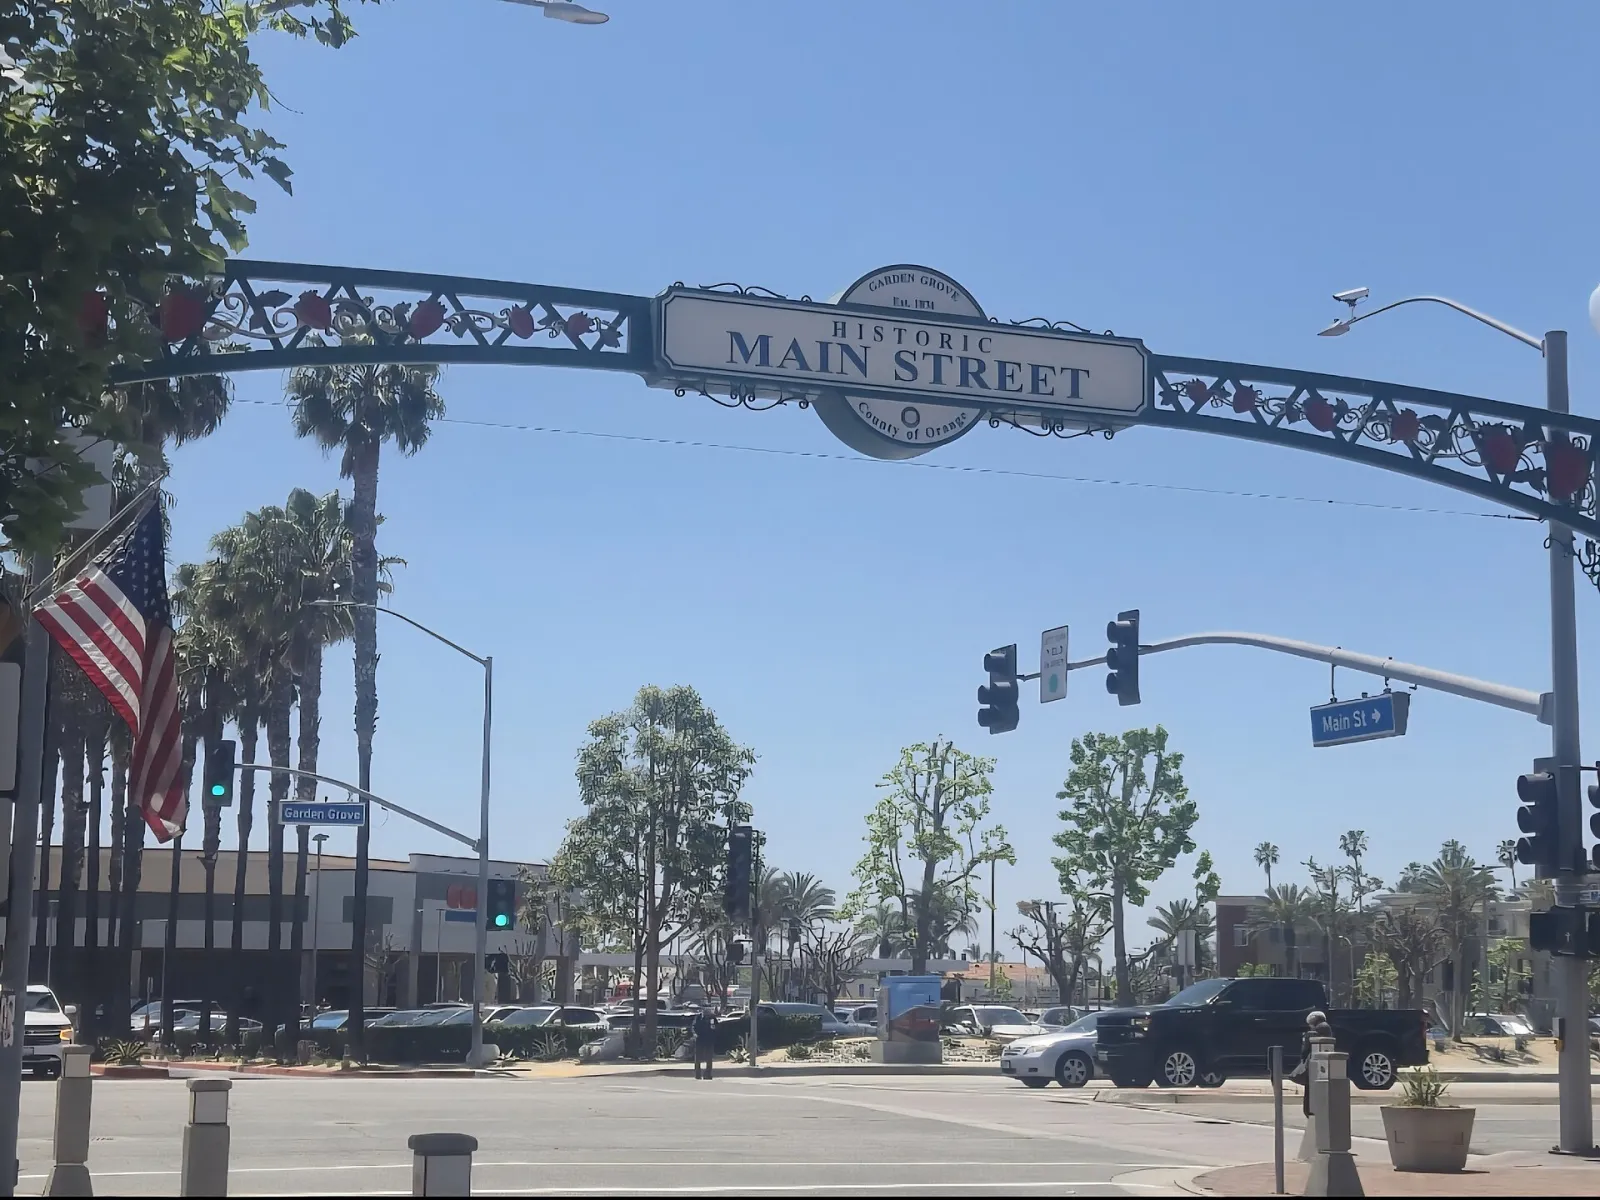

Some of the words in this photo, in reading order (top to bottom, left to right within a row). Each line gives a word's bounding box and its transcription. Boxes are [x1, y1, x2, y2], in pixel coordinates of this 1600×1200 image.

[869, 273, 915, 292] GARDEN
[920, 275, 960, 302] GROVE
[832, 320, 992, 353] HISTORIC
[725, 330, 871, 378] MAIN
[894, 350, 1090, 400] STREET
[858, 402, 900, 437] County
[906, 428, 919, 440] of
[925, 412, 967, 438] Orange
[1322, 714, 1351, 733] Main
[1353, 709, 1368, 728] St
[284, 807, 324, 820] Garden
[327, 808, 361, 820] Grove
